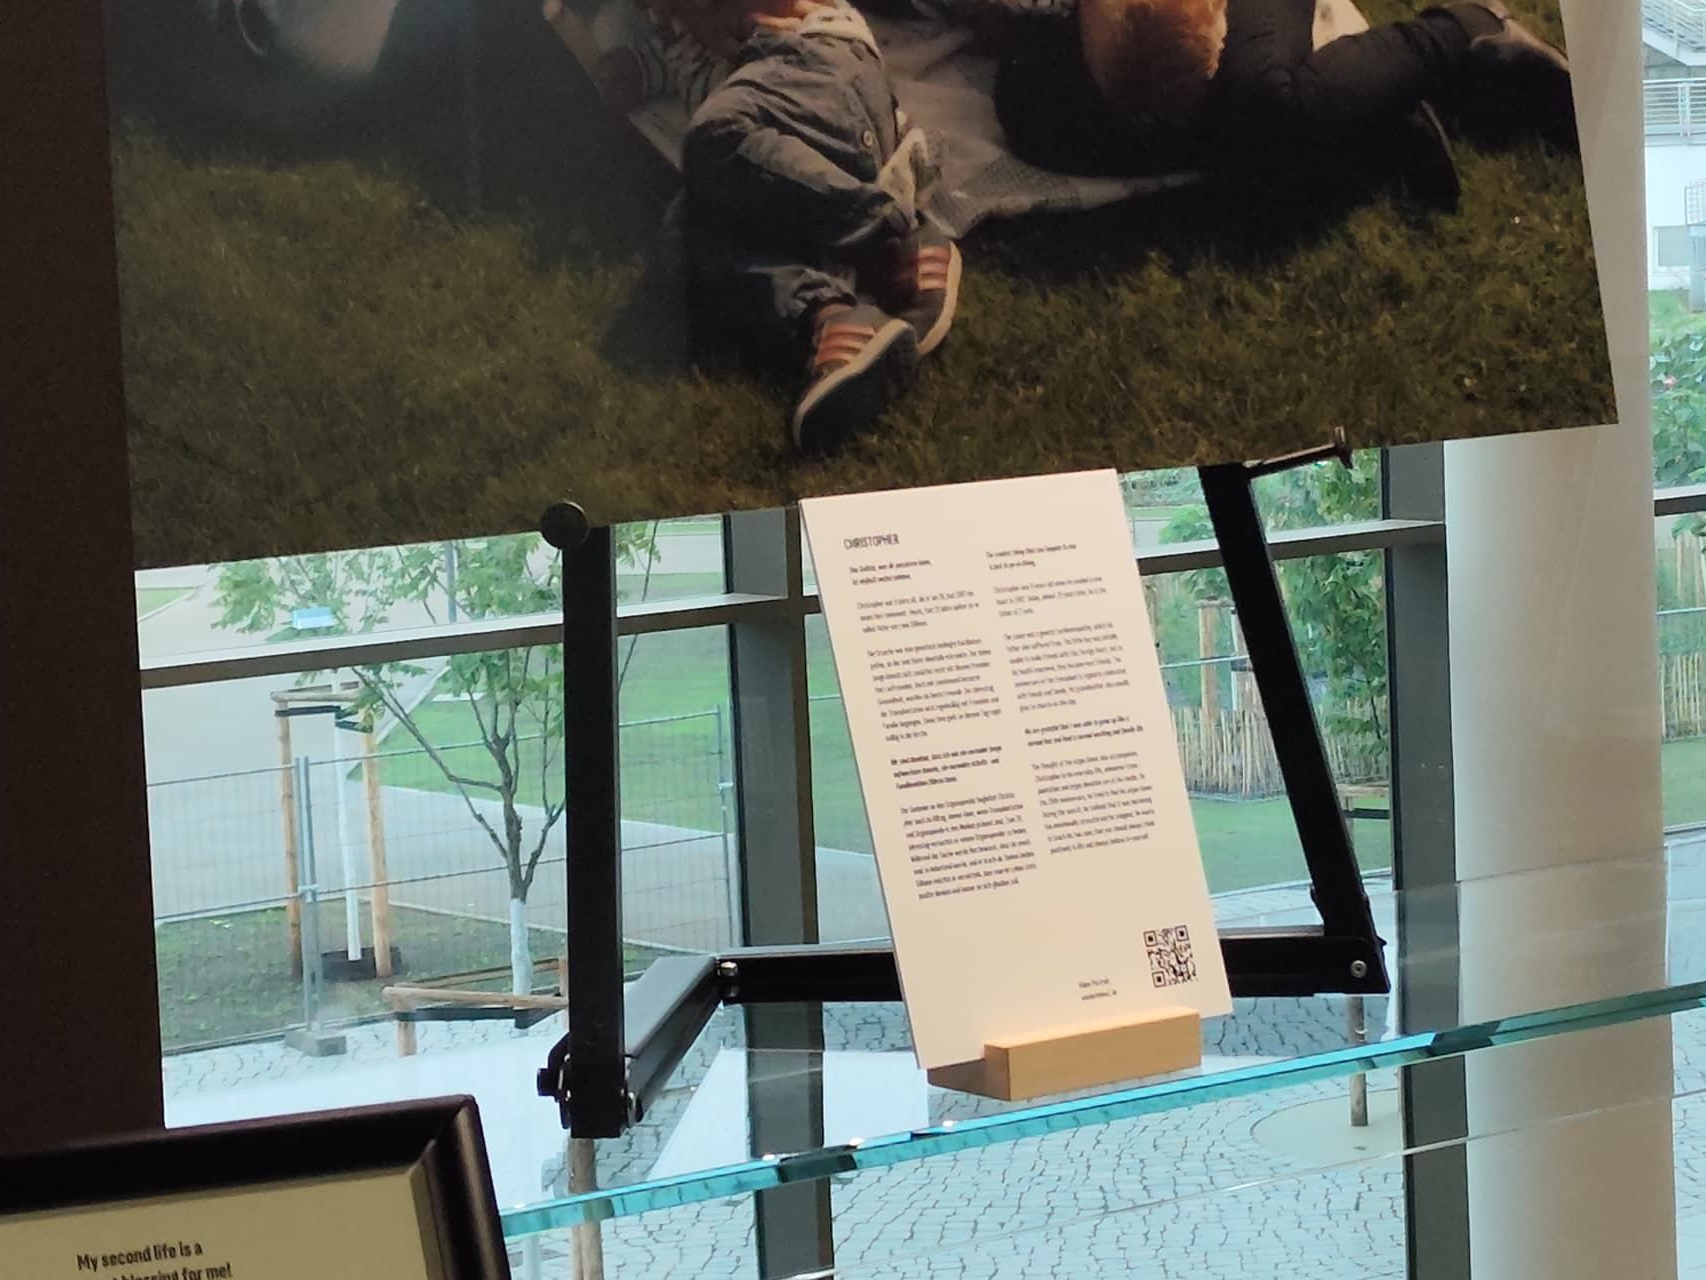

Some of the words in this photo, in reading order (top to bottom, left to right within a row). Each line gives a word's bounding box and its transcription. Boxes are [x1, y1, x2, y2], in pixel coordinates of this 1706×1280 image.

[843, 533, 900, 550] CHRISTOPHER
[76, 1253, 98, 1272] My
[100, 1244, 152, 1268] second
[152, 1242, 177, 1261] life
[177, 1240, 192, 1257] is
[193, 1241, 203, 1256] a
[204, 1261, 232, 1280] me!
